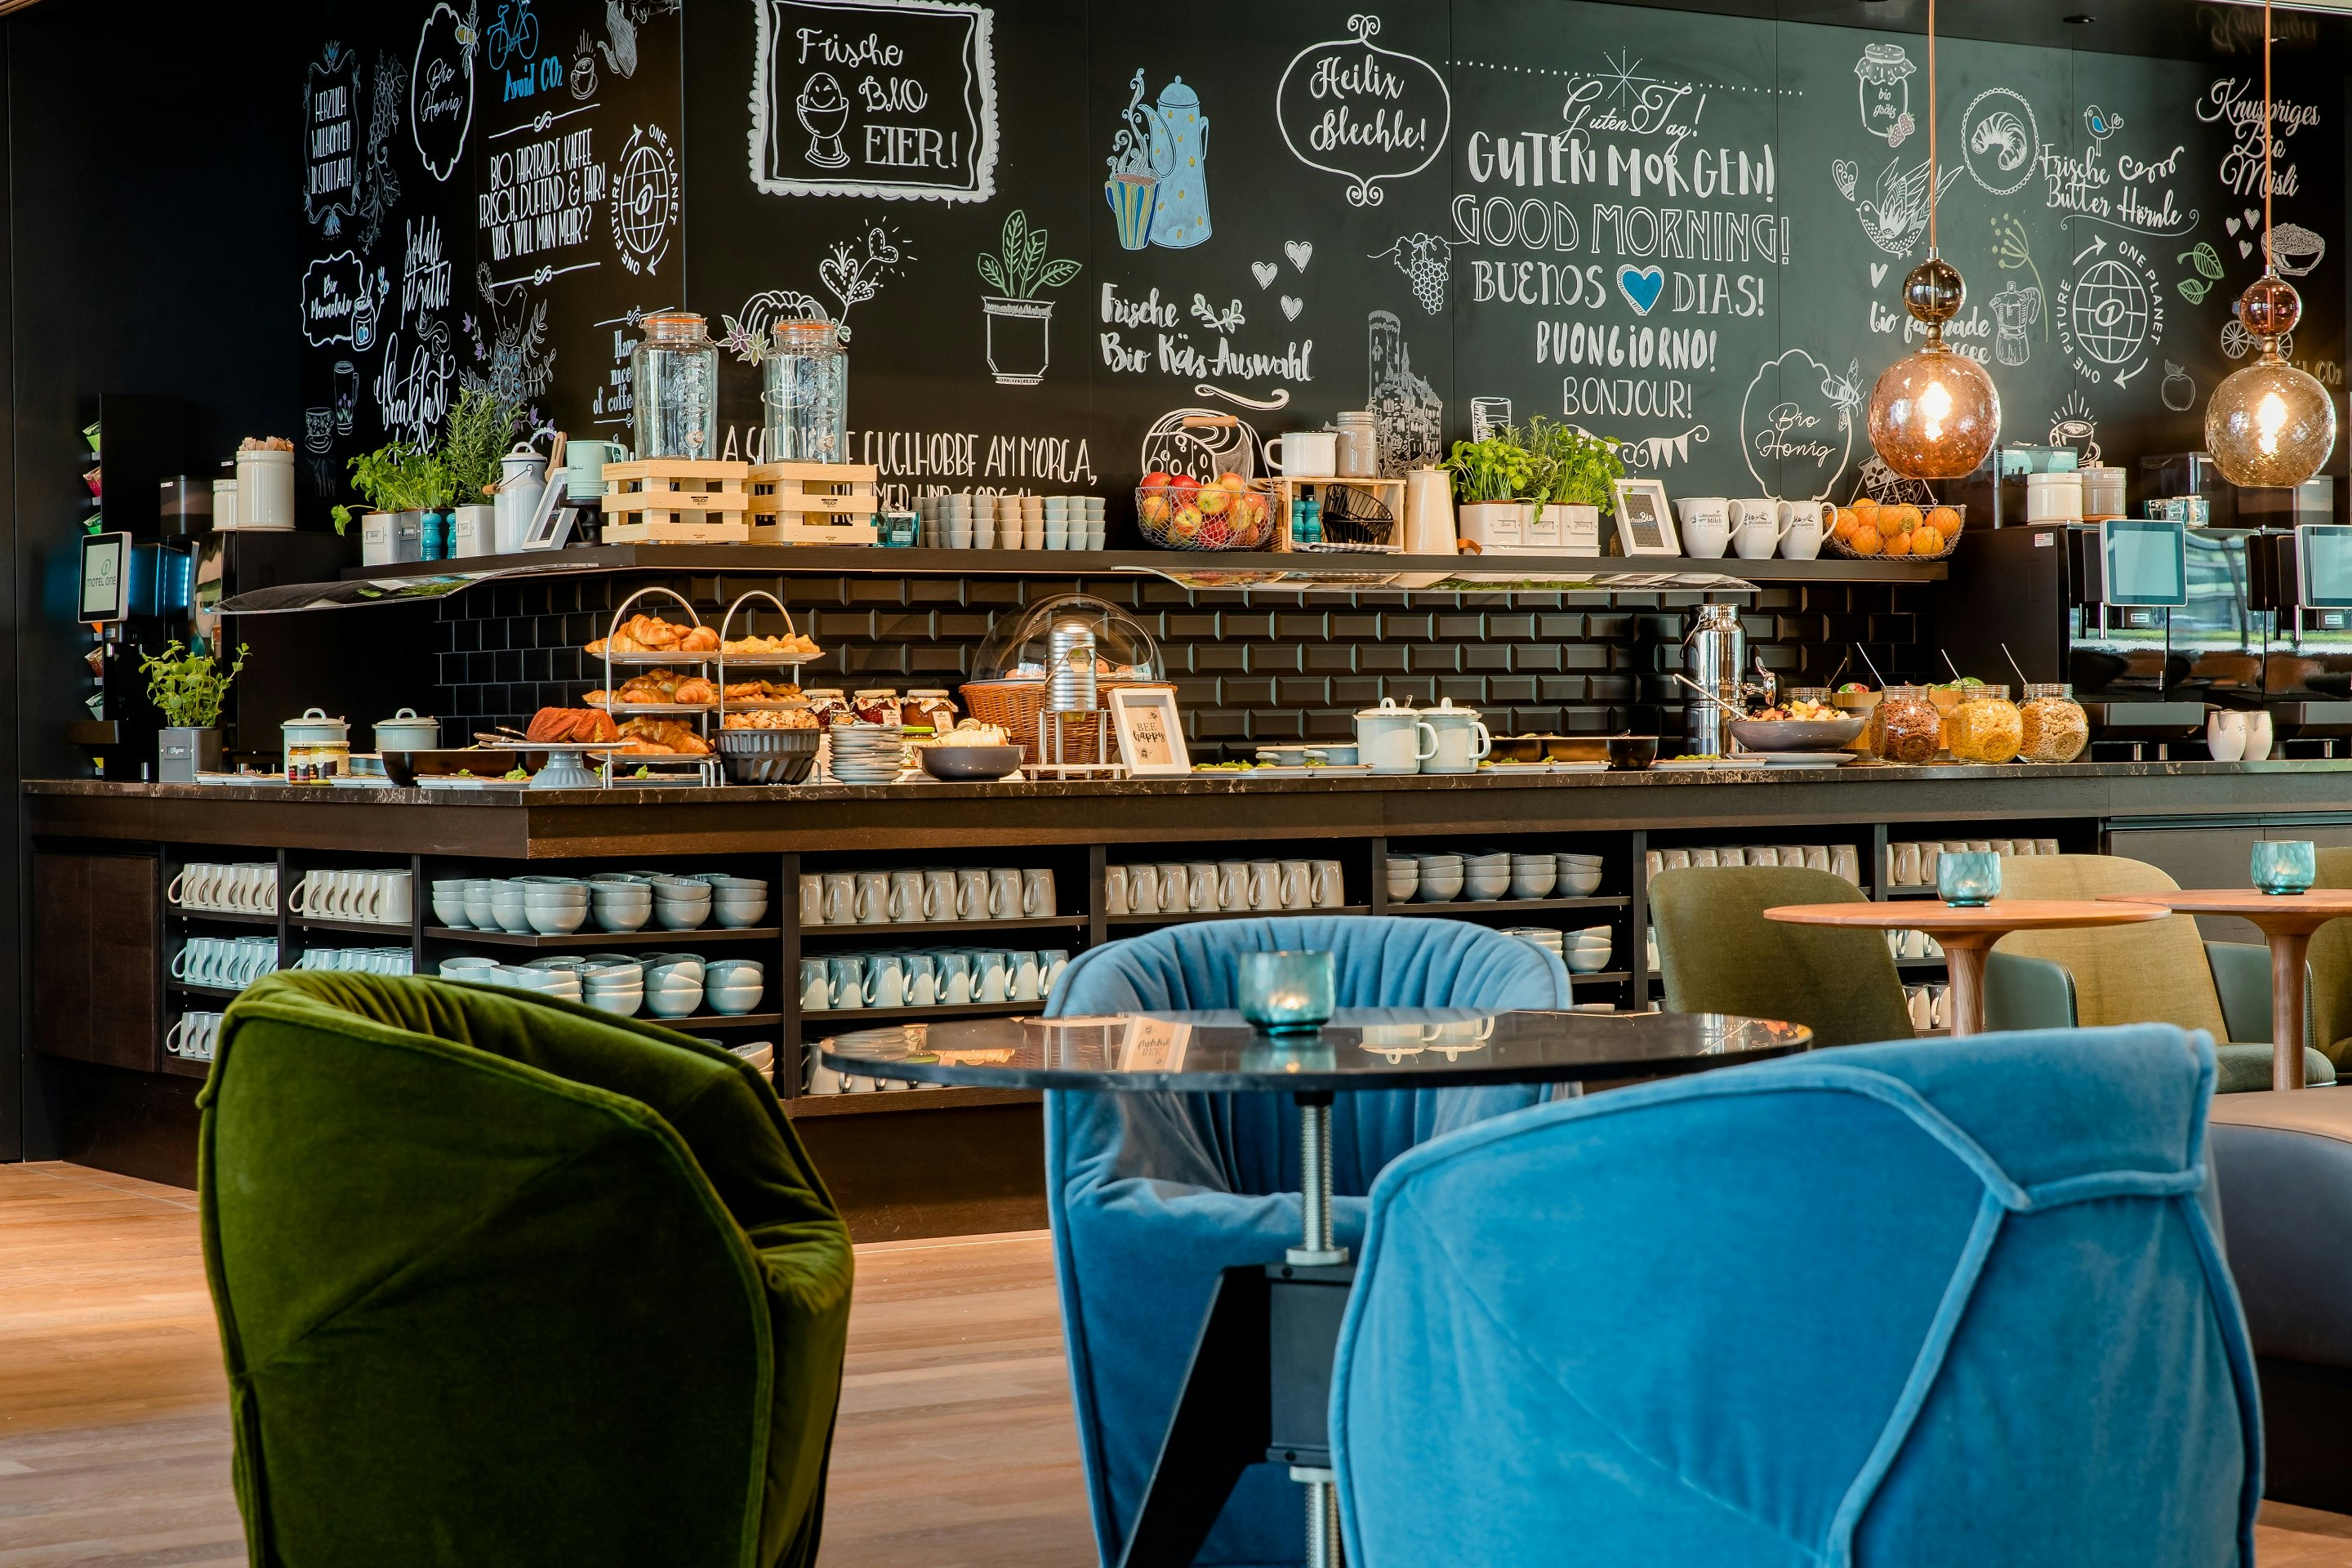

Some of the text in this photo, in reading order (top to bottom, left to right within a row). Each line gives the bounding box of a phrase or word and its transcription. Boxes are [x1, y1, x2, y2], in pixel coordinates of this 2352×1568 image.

[796, 28, 903, 67] Frische
[426, 58, 455, 91] Bio
[503, 63, 535, 102] Avoid
[1310, 54, 1404, 100] Heilix
[1878, 87, 1891, 100] bio
[315, 86, 346, 122] HERZLICH
[421, 91, 462, 122] Honig
[1552, 77, 1706, 165] Guten Tag!
[2195, 78, 2320, 136] Knuspriges
[311, 120, 350, 158] WILLKOMMEN
[863, 124, 958, 168] EIER!
[1310, 106, 1427, 152] Blechle!
[2233, 119, 2286, 158] Bio
[490, 128, 593, 191] BIO FAIRTRADE KAFFEE
[648, 124, 679, 225] ONE PLANET
[1468, 131, 1775, 203] GUTEN MORGEN!
[2039, 144, 2110, 185] Frische
[479, 162, 606, 229] FRISCH, DUFTEND & FAIR!
[2046, 176, 2183, 228] Butter Hörnle
[492, 204, 592, 261] WAS WILL MAN MEHR?
[611, 174, 640, 275] ONE FUTURE
[1452, 194, 1790, 265] GOOD MORNING!
[310, 293, 352, 320] Marmelade
[323, 274, 337, 298] Bio
[1101, 282, 1179, 328] Frische
[1673, 271, 1766, 317] DIAS!
[2118, 241, 2164, 346] ONE PLANET
[1870, 301, 1991, 344] bio farade
[2057, 278, 2101, 385] ONE FUTURE
[1100, 331, 1152, 373] Bio
[374, 332, 456, 454] breakfast
[593, 384, 634, 415] of coffe
[1563, 376, 1693, 420] BONJOUR!
[1767, 401, 1821, 430] Bio
[985, 435, 1015, 477] AM
[1755, 430, 1837, 468] Honig
[86, 576, 116, 587] MOTEL ONE
[1133, 730, 1166, 742] happy
[1137, 723, 1157, 732] BEE
